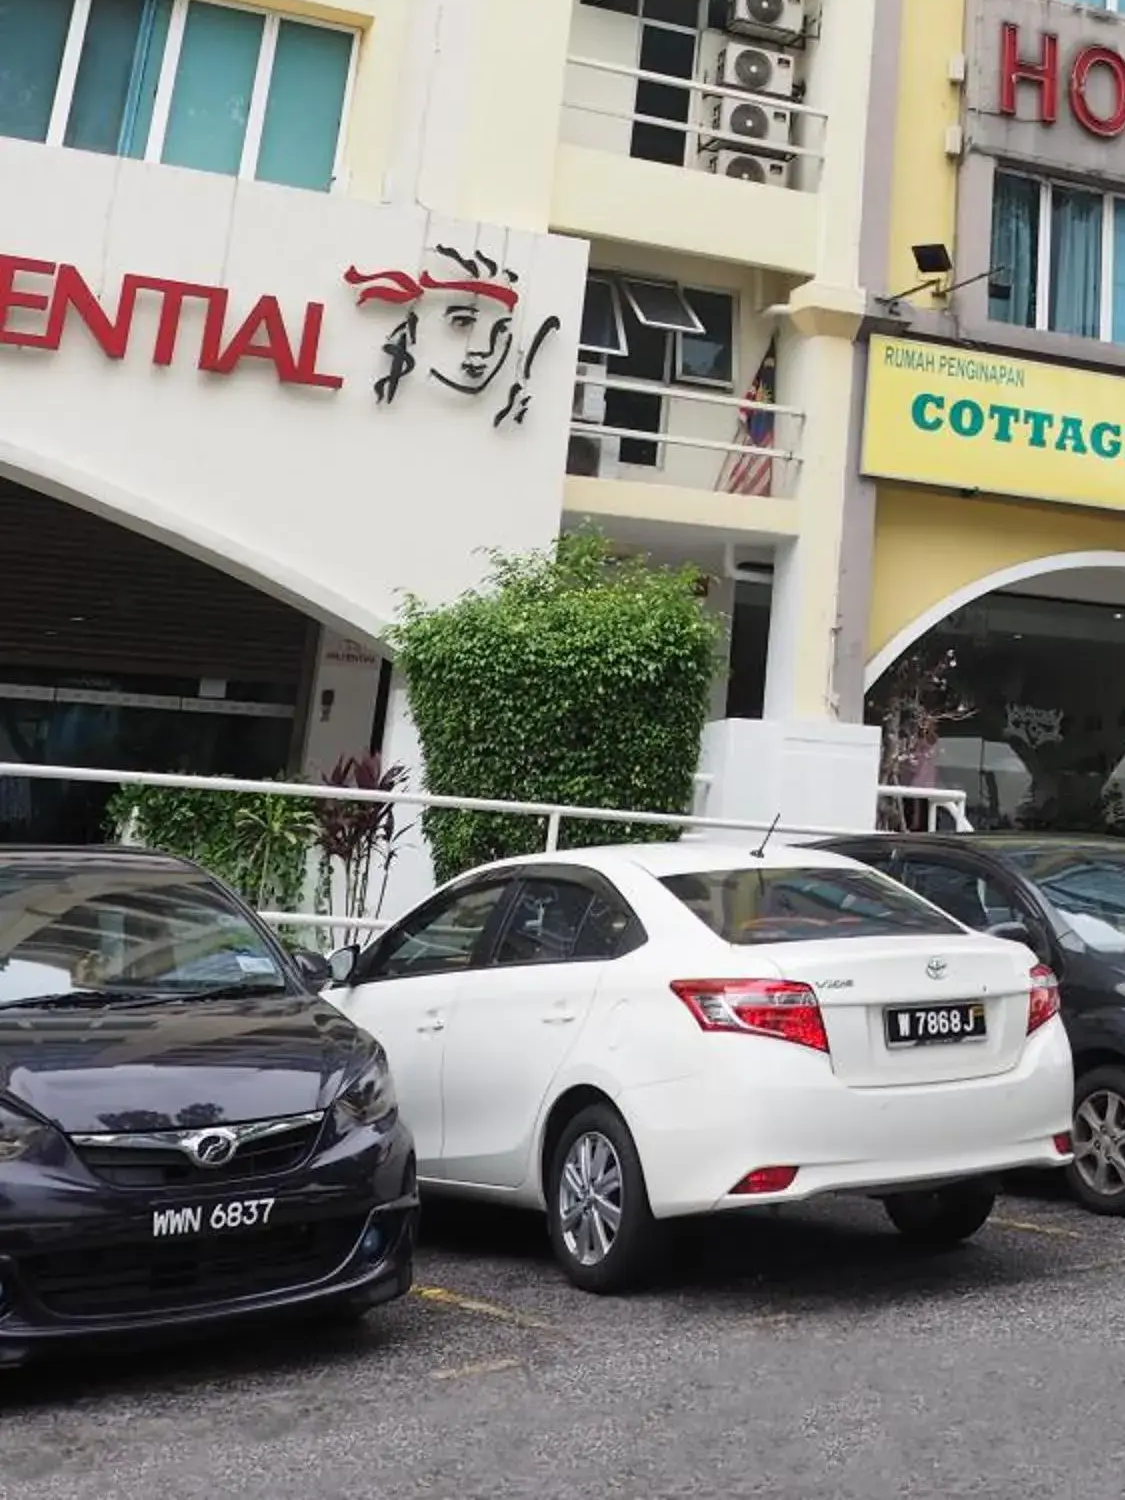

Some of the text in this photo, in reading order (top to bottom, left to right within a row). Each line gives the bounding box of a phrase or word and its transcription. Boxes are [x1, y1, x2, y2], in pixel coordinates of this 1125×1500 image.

[0, 253, 343, 389] ENTIAL
[884, 345, 1025, 388] RUMAH PENGINAPAN
[897, 1007, 974, 1037] W 7868 J
[153, 1197, 275, 1237] WWN 6837
